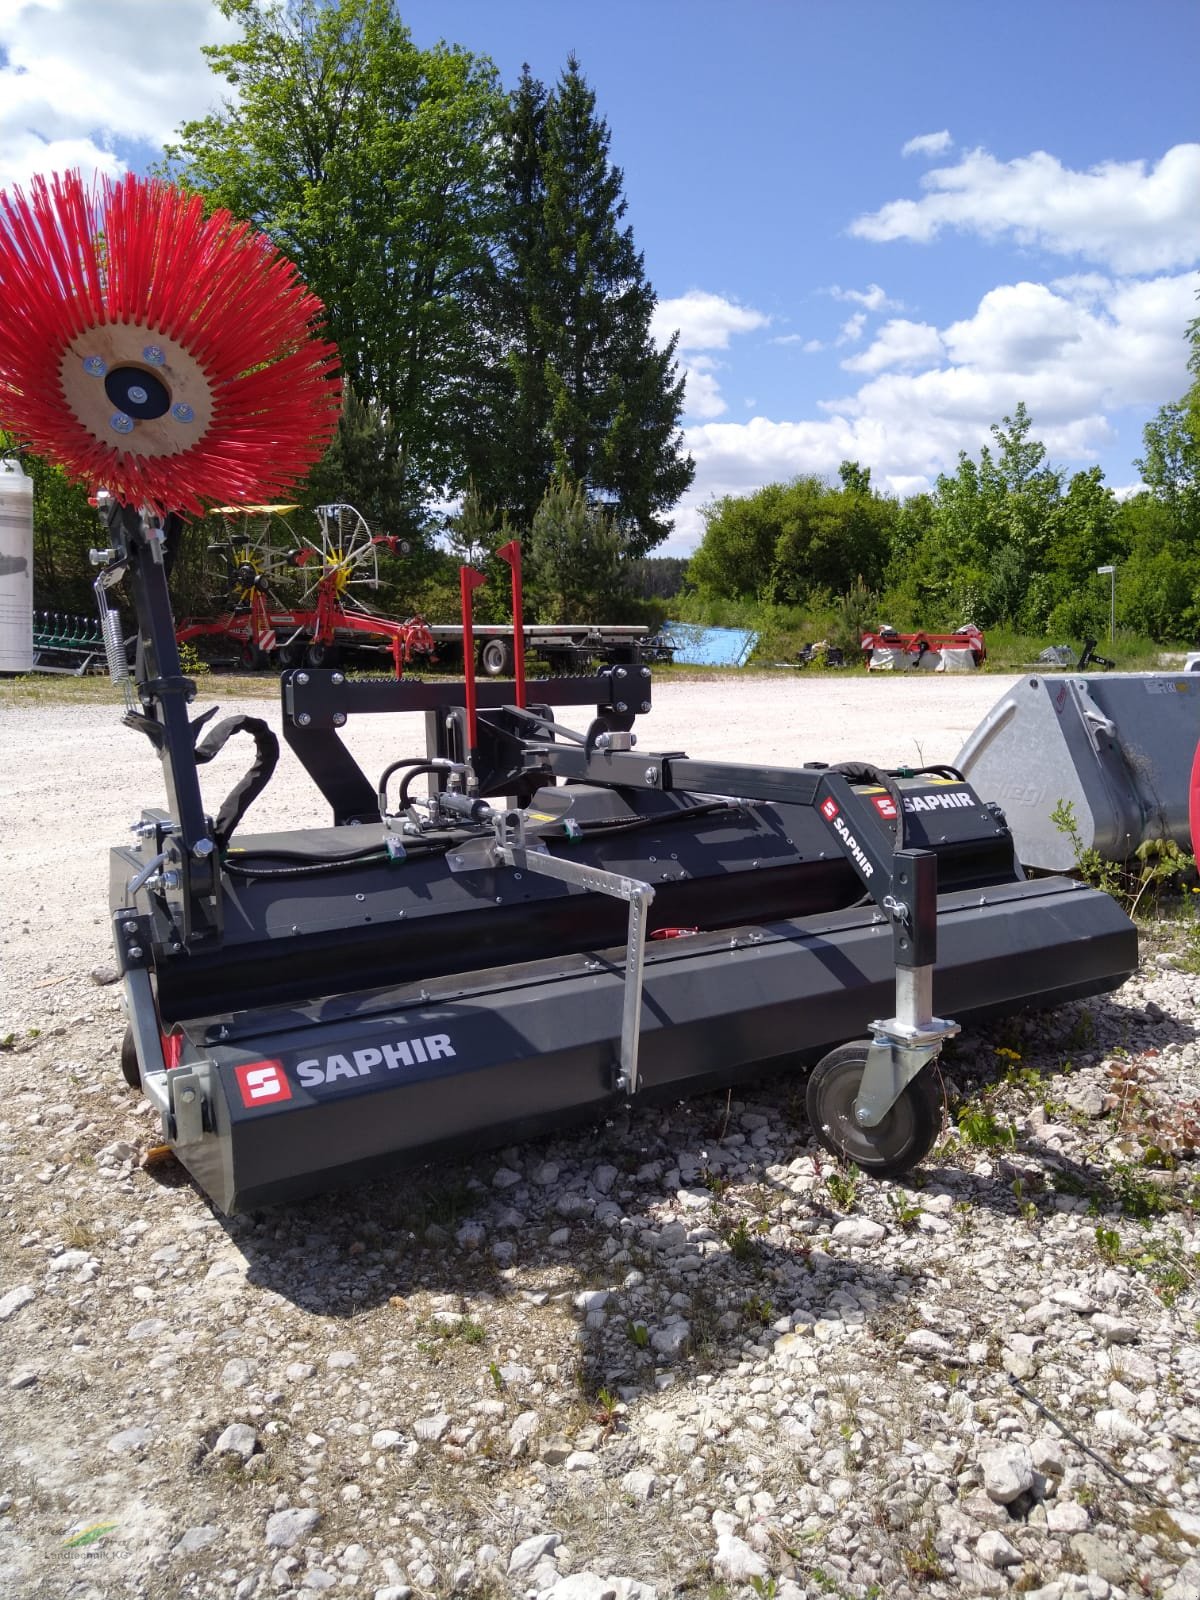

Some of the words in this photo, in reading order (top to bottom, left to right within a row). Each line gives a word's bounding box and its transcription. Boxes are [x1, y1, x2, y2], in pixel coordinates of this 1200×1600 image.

[903, 792, 976, 813] SAPHIR
[833, 817, 874, 878] SAPHIR
[296, 1033, 456, 1087] SAPHIR
